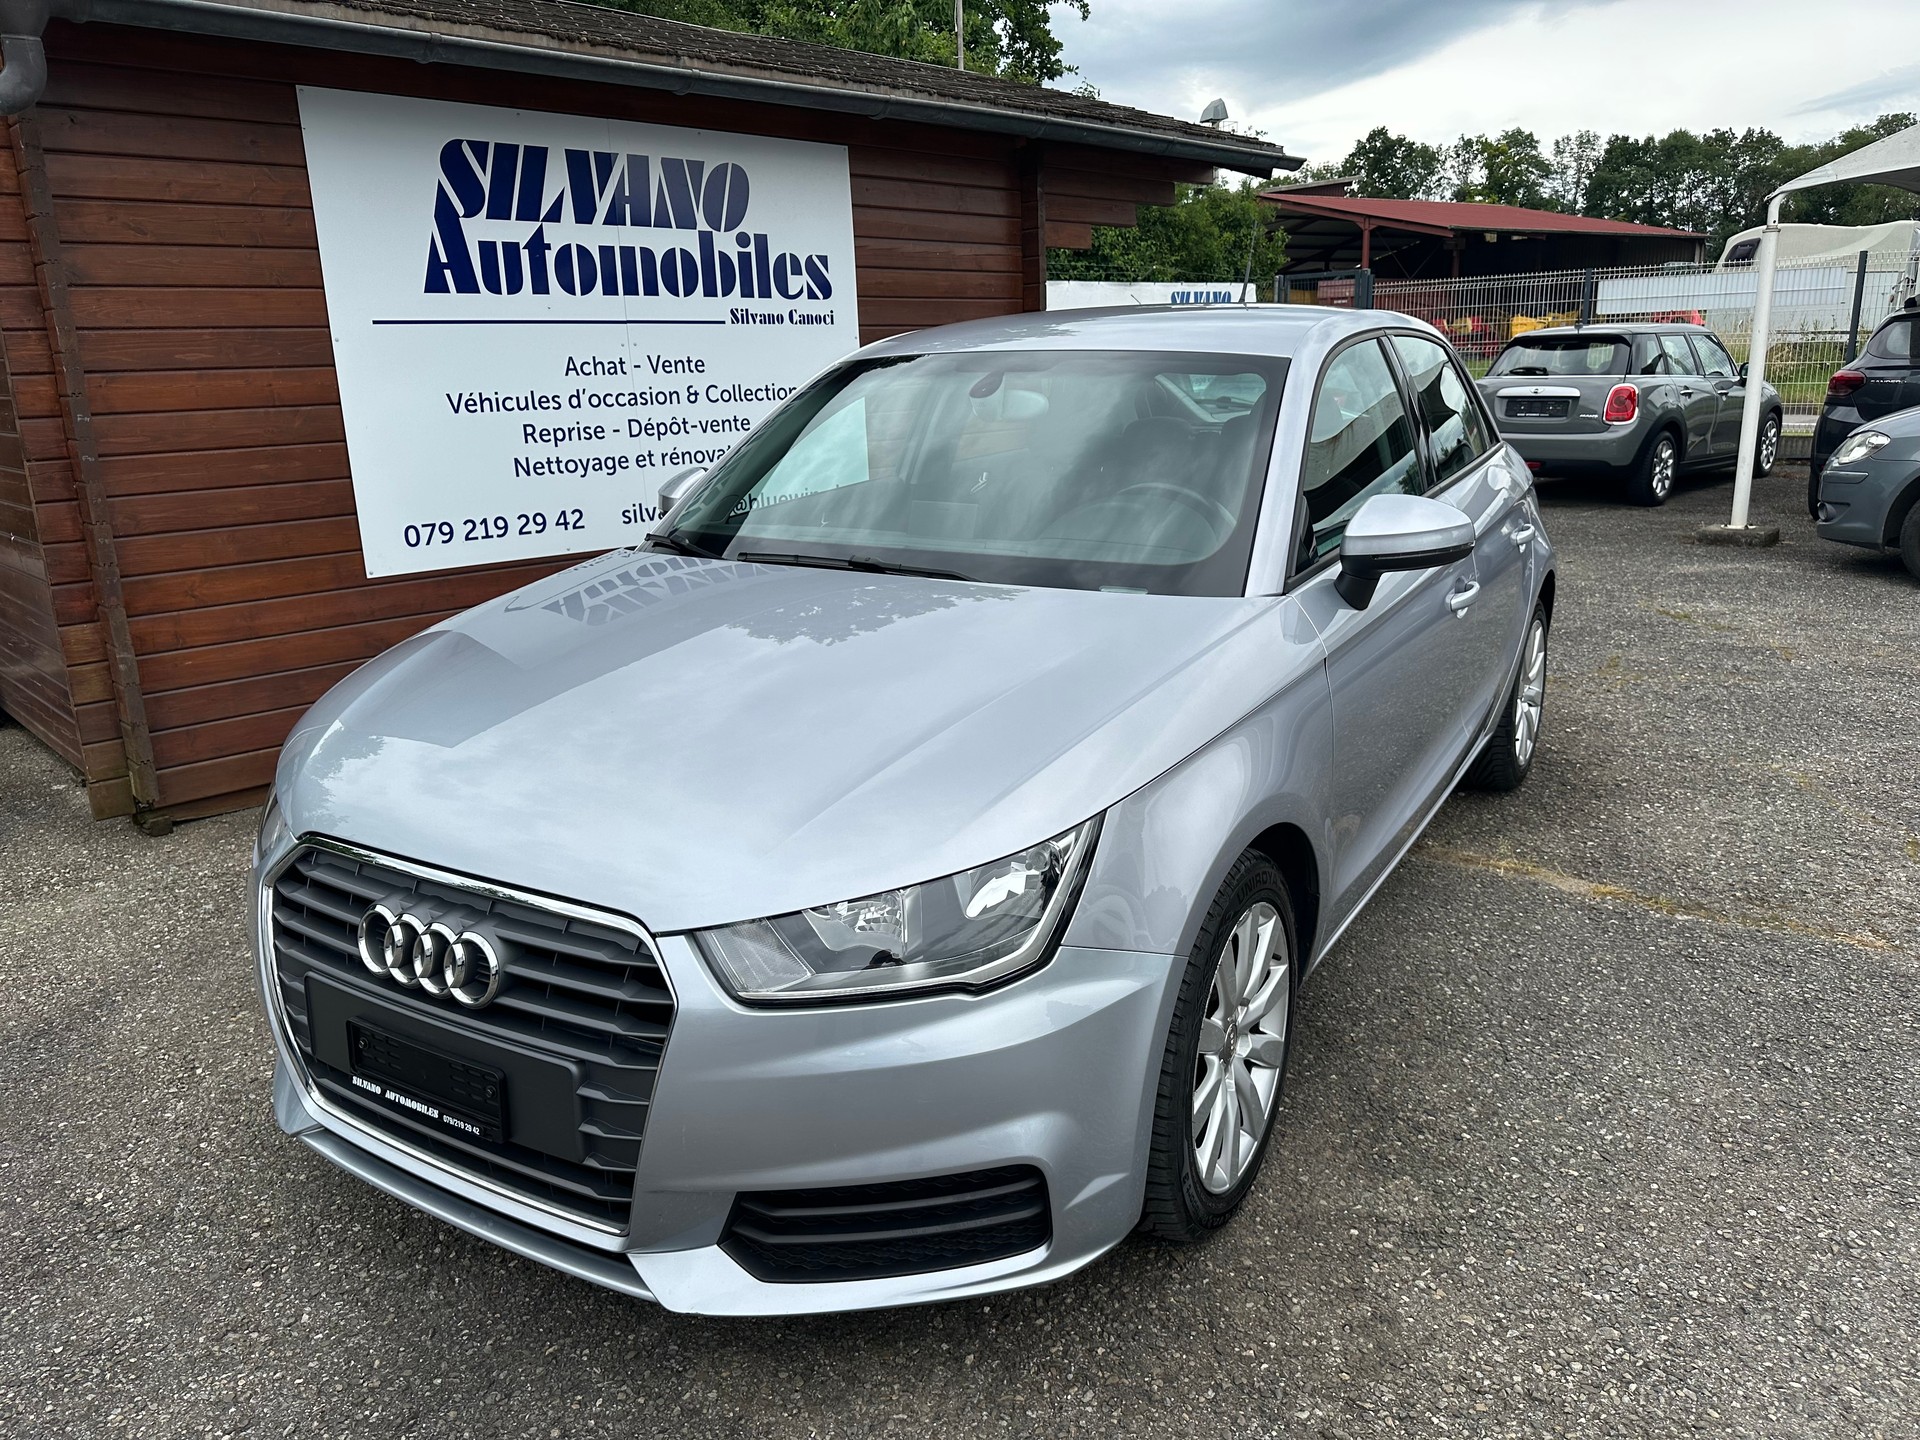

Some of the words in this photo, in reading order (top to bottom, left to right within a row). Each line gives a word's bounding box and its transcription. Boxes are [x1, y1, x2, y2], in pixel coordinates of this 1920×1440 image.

[434, 139, 750, 233] SILVANO
[424, 215, 833, 301] Automobiles
[730, 308, 784, 325] Silvano
[788, 309, 835, 326] Canoci
[564, 355, 628, 377] Achat
[646, 354, 706, 375] Vente
[446, 391, 562, 414] Véhicules
[568, 386, 681, 409] d'occasion
[686, 385, 700, 405] &
[522, 420, 606, 448] Reprise
[627, 415, 751, 441] Dépôt-vente
[513, 454, 630, 479] Nettoyage
[635, 450, 656, 468] et
[661, 444, 732, 467] rénova
[403, 521, 455, 548] 079
[462, 516, 509, 542] 219
[516, 512, 547, 536] 29
[554, 508, 586, 531] 42
[352, 1075, 382, 1095] SILVANO
[384, 1089, 439, 1119] AUTOMOBILES
[443, 1114, 464, 1130] 079/219
[464, 1122, 472, 1132] 29
[472, 1126, 480, 1136] 42
